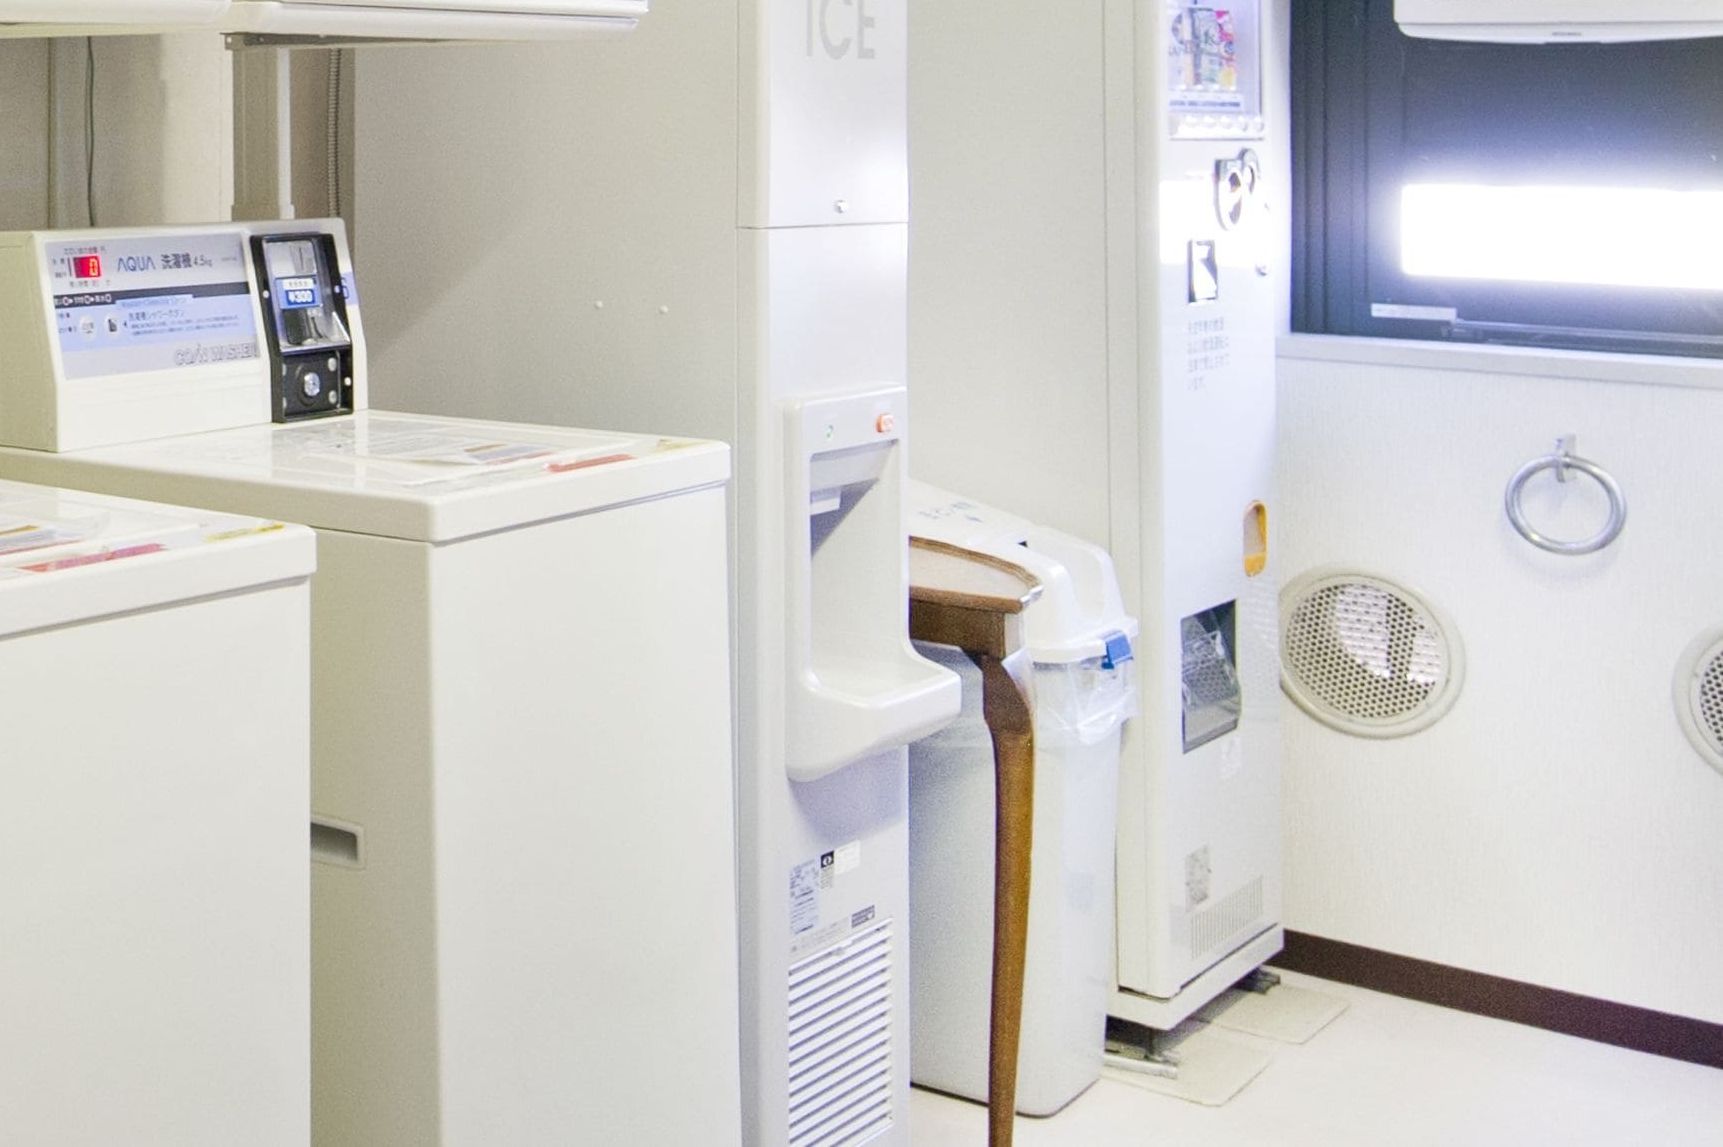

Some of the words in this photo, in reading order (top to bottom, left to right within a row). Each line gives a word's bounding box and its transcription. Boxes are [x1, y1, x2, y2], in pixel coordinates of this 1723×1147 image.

[89, 258, 98, 277] 0
[117, 255, 156, 273] AQUA
[161, 252, 193, 270] 洗濯機
